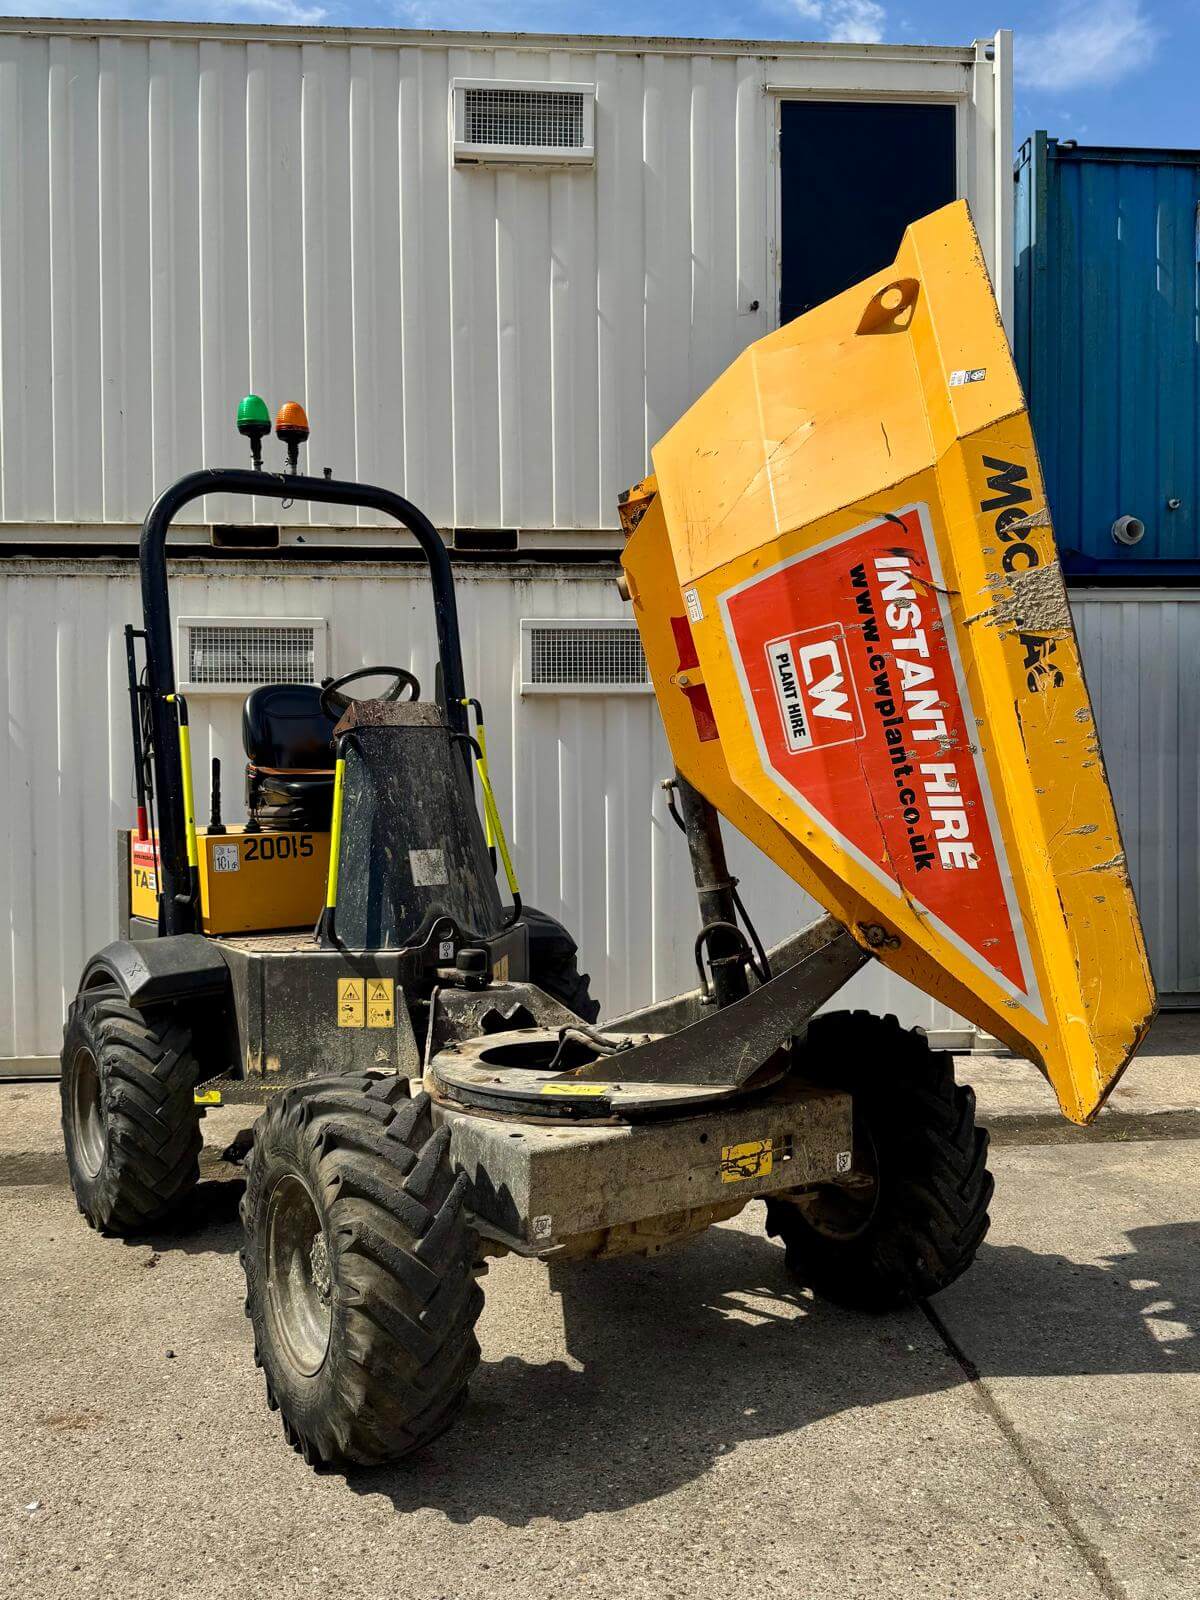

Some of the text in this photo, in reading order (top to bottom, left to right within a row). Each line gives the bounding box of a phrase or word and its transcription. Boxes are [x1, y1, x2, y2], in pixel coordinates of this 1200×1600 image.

[776, 653, 806, 738] PLANT HIRE
[799, 640, 853, 721] CW
[850, 562, 935, 873] www.cwplant.co.uk
[874, 557, 978, 870] INSTANT HIRE
[243, 834, 314, 861] 20015
